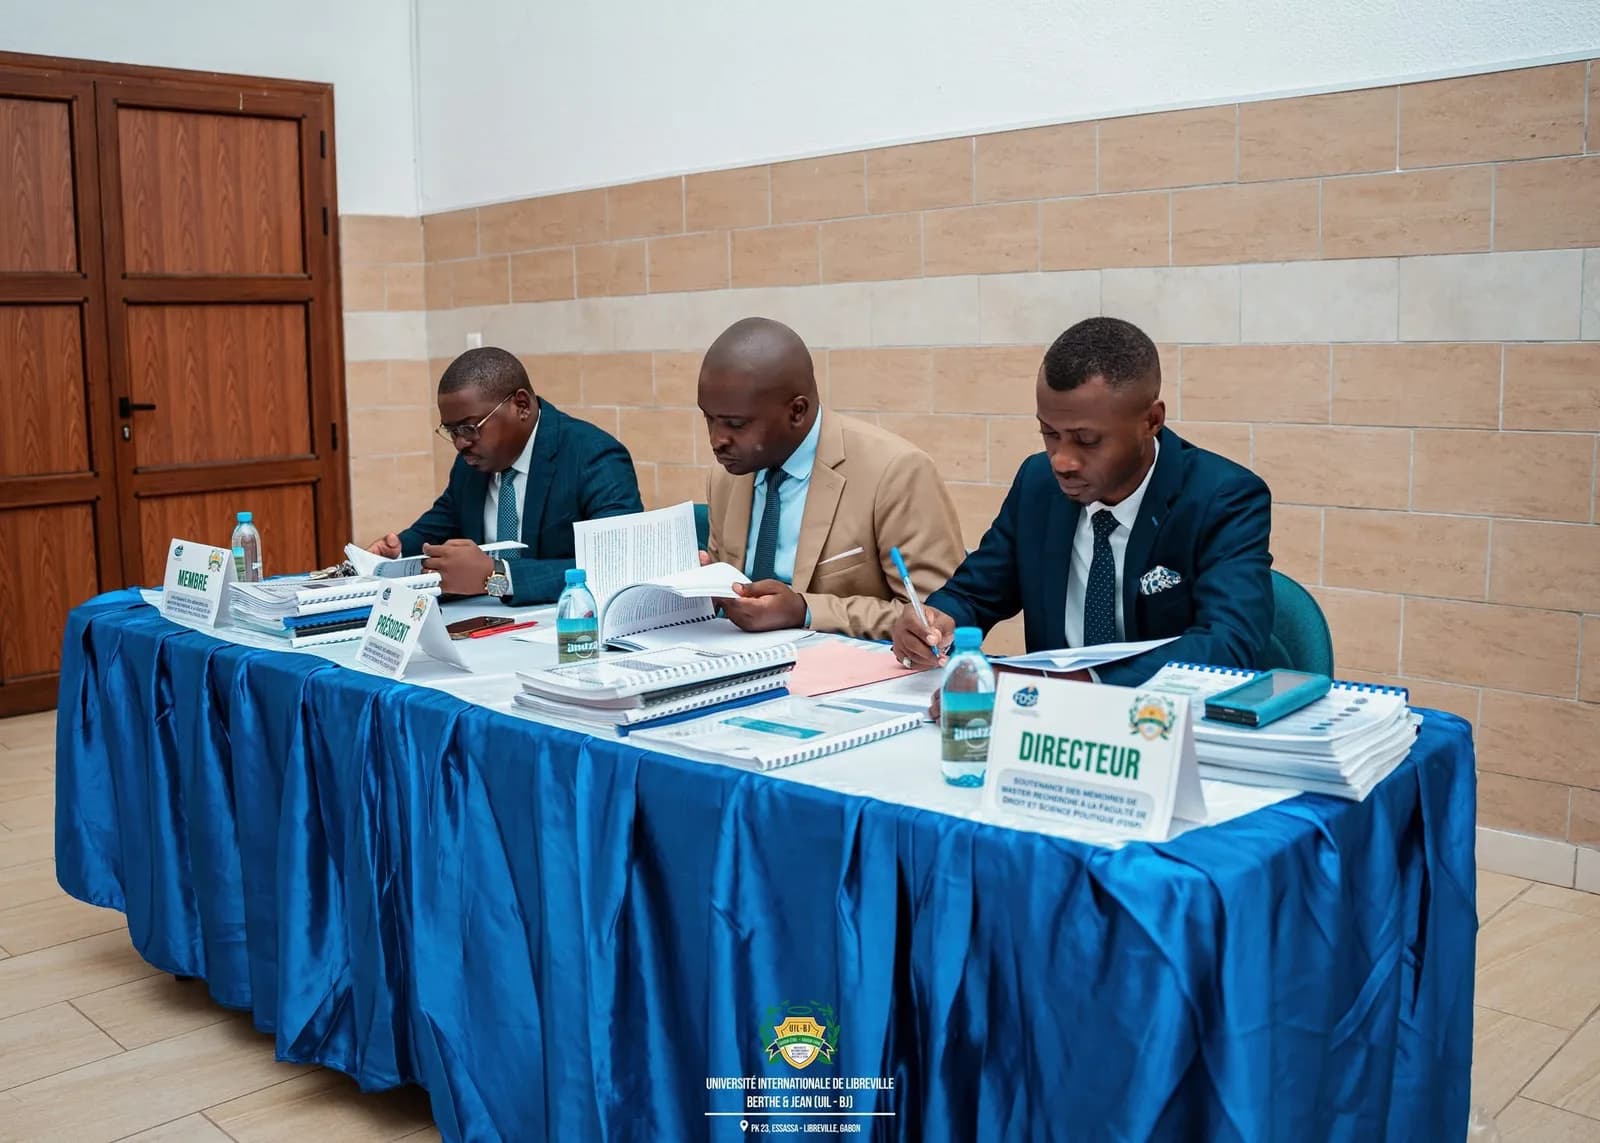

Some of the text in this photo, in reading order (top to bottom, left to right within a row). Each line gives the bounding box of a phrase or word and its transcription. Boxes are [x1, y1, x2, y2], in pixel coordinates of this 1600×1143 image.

[177, 569, 209, 592] MEMBRE
[375, 613, 411, 644] PRÉSIDENT
[1019, 731, 1142, 780] DIRECTEUR
[1001, 785, 1031, 797] MASTER
[1014, 777, 1063, 792] SOUTENANCE
[1065, 786, 1081, 796] DES
[1126, 797, 1137, 806] DE
